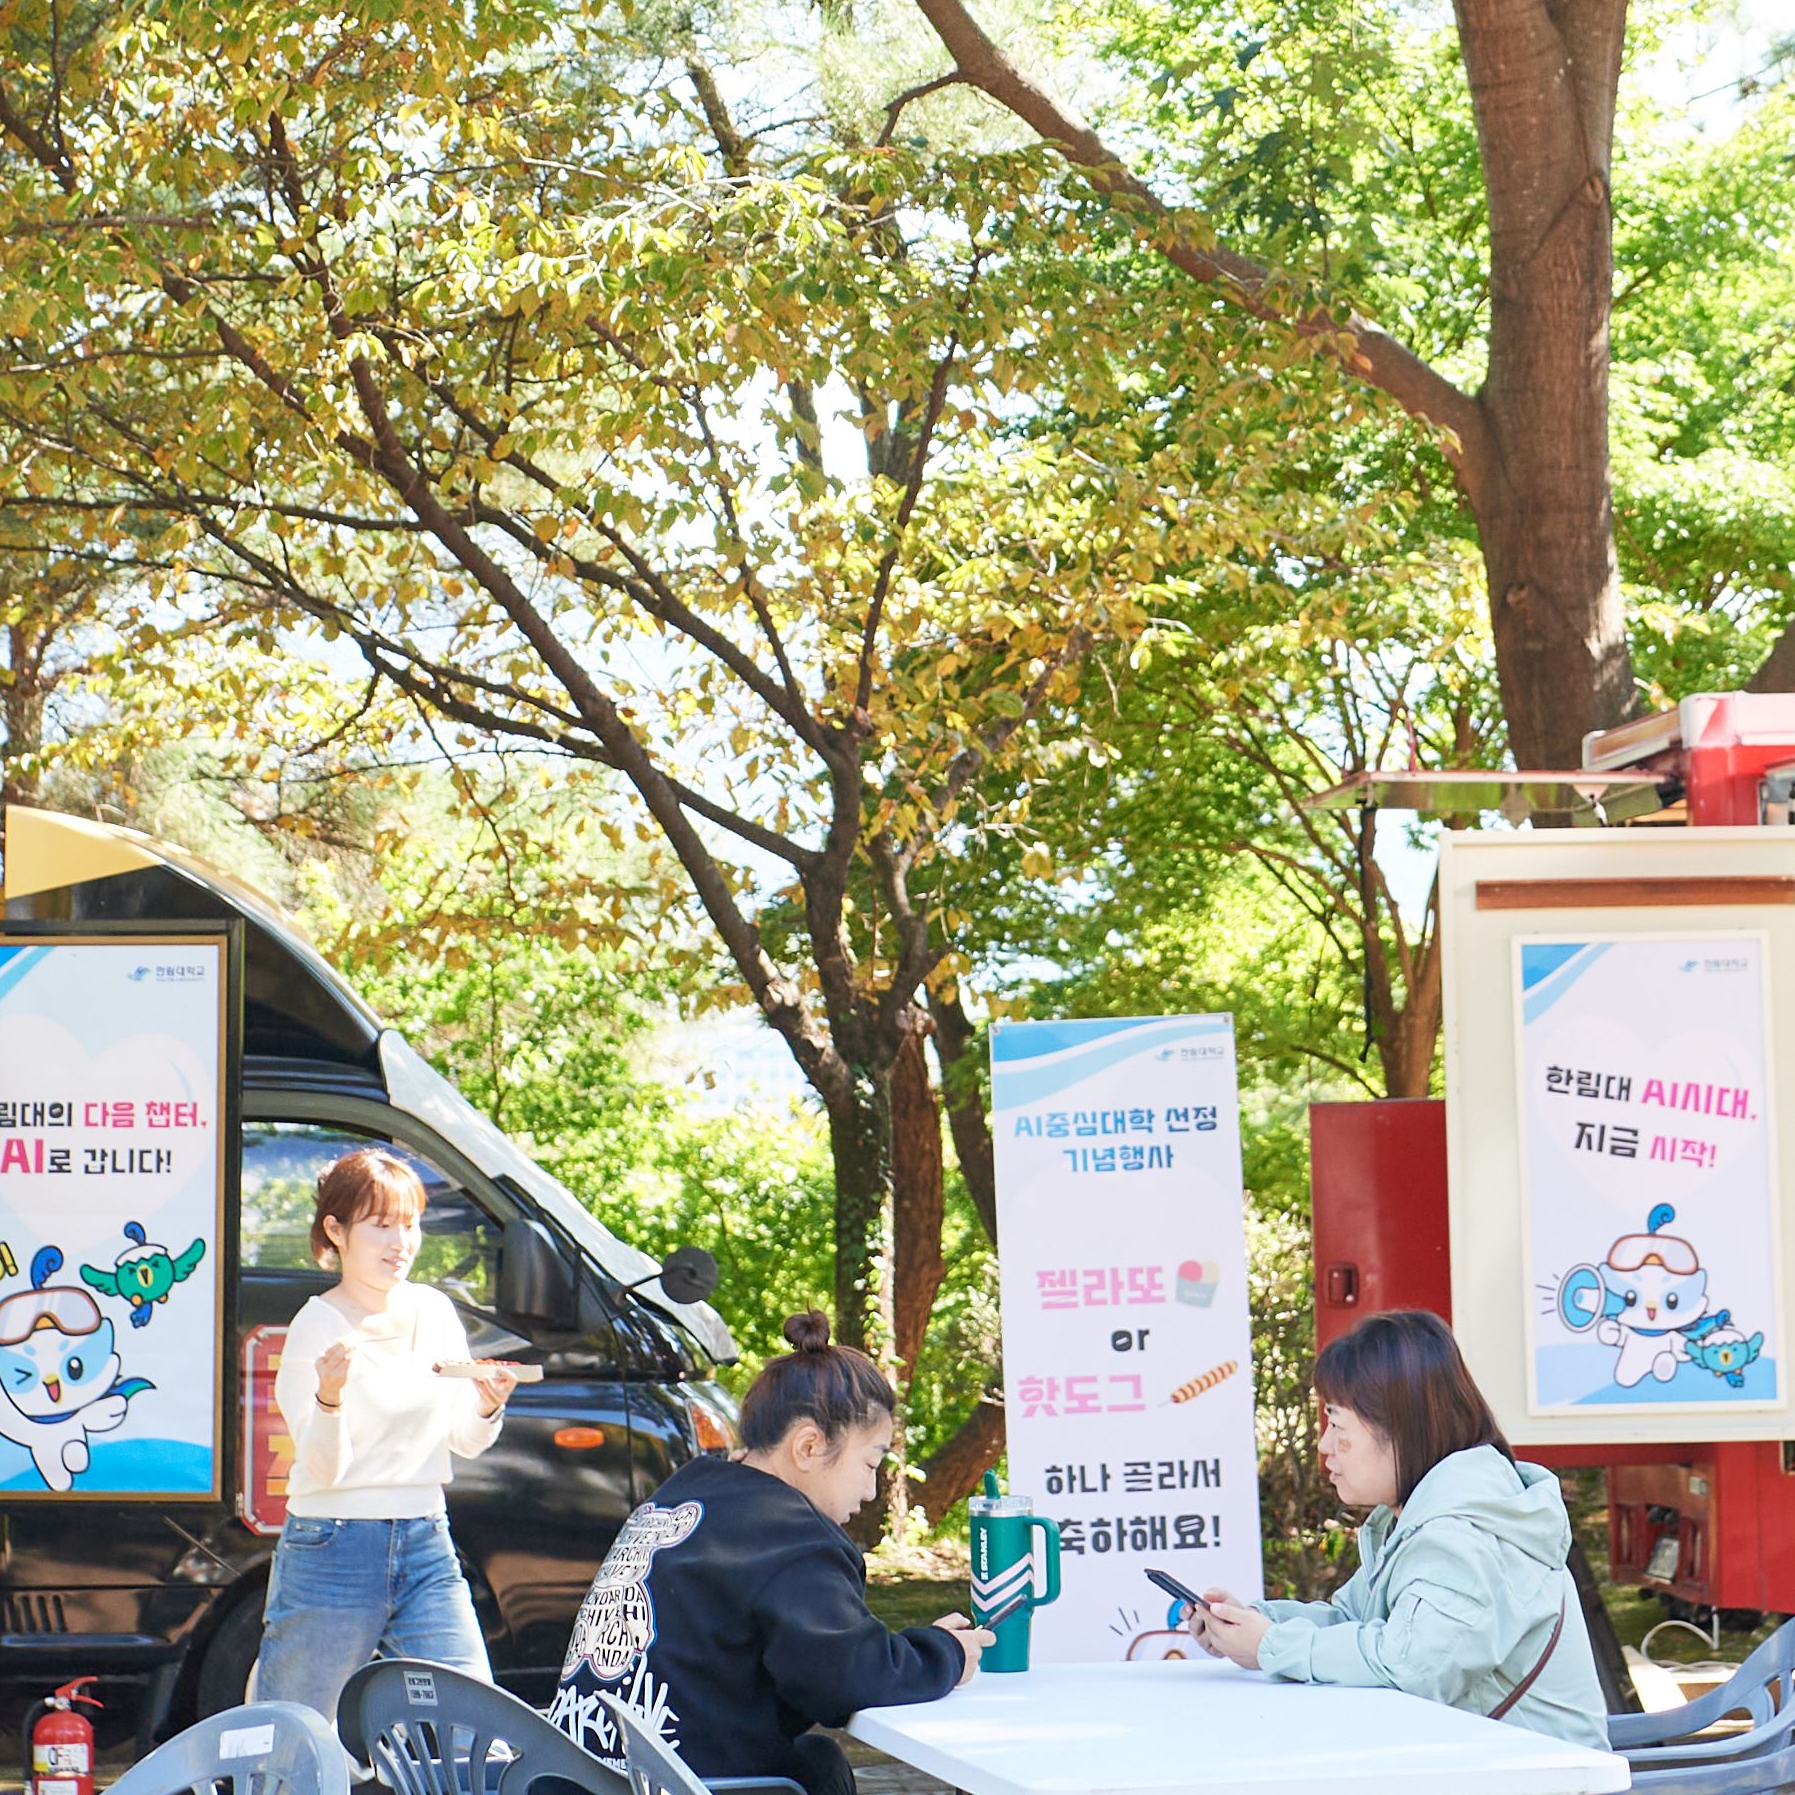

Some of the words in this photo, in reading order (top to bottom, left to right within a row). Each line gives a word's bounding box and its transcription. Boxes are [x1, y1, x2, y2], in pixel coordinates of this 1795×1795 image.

[1546, 1065, 1632, 1102] 한림대
[84, 1100, 135, 1129] 다음
[1015, 1108, 1155, 1138] AI중심대학
[1165, 1106, 1218, 1134] 선정
[0, 1138, 72, 1174] AI로
[84, 1148, 172, 1174] 갑니다!
[1062, 1145, 1173, 1173] 기념행사
[1574, 1121, 1639, 1158] 지금
[1649, 1135, 1716, 1168] 시작!
[1036, 1264, 1166, 1310] 젤라또
[1111, 1327, 1149, 1352] or
[1018, 1375, 1146, 1417] 핫도그
[1045, 1464, 1110, 1494] 하나
[1124, 1459, 1221, 1492] 골라서
[1059, 1514, 1221, 1555] 축하해요!
